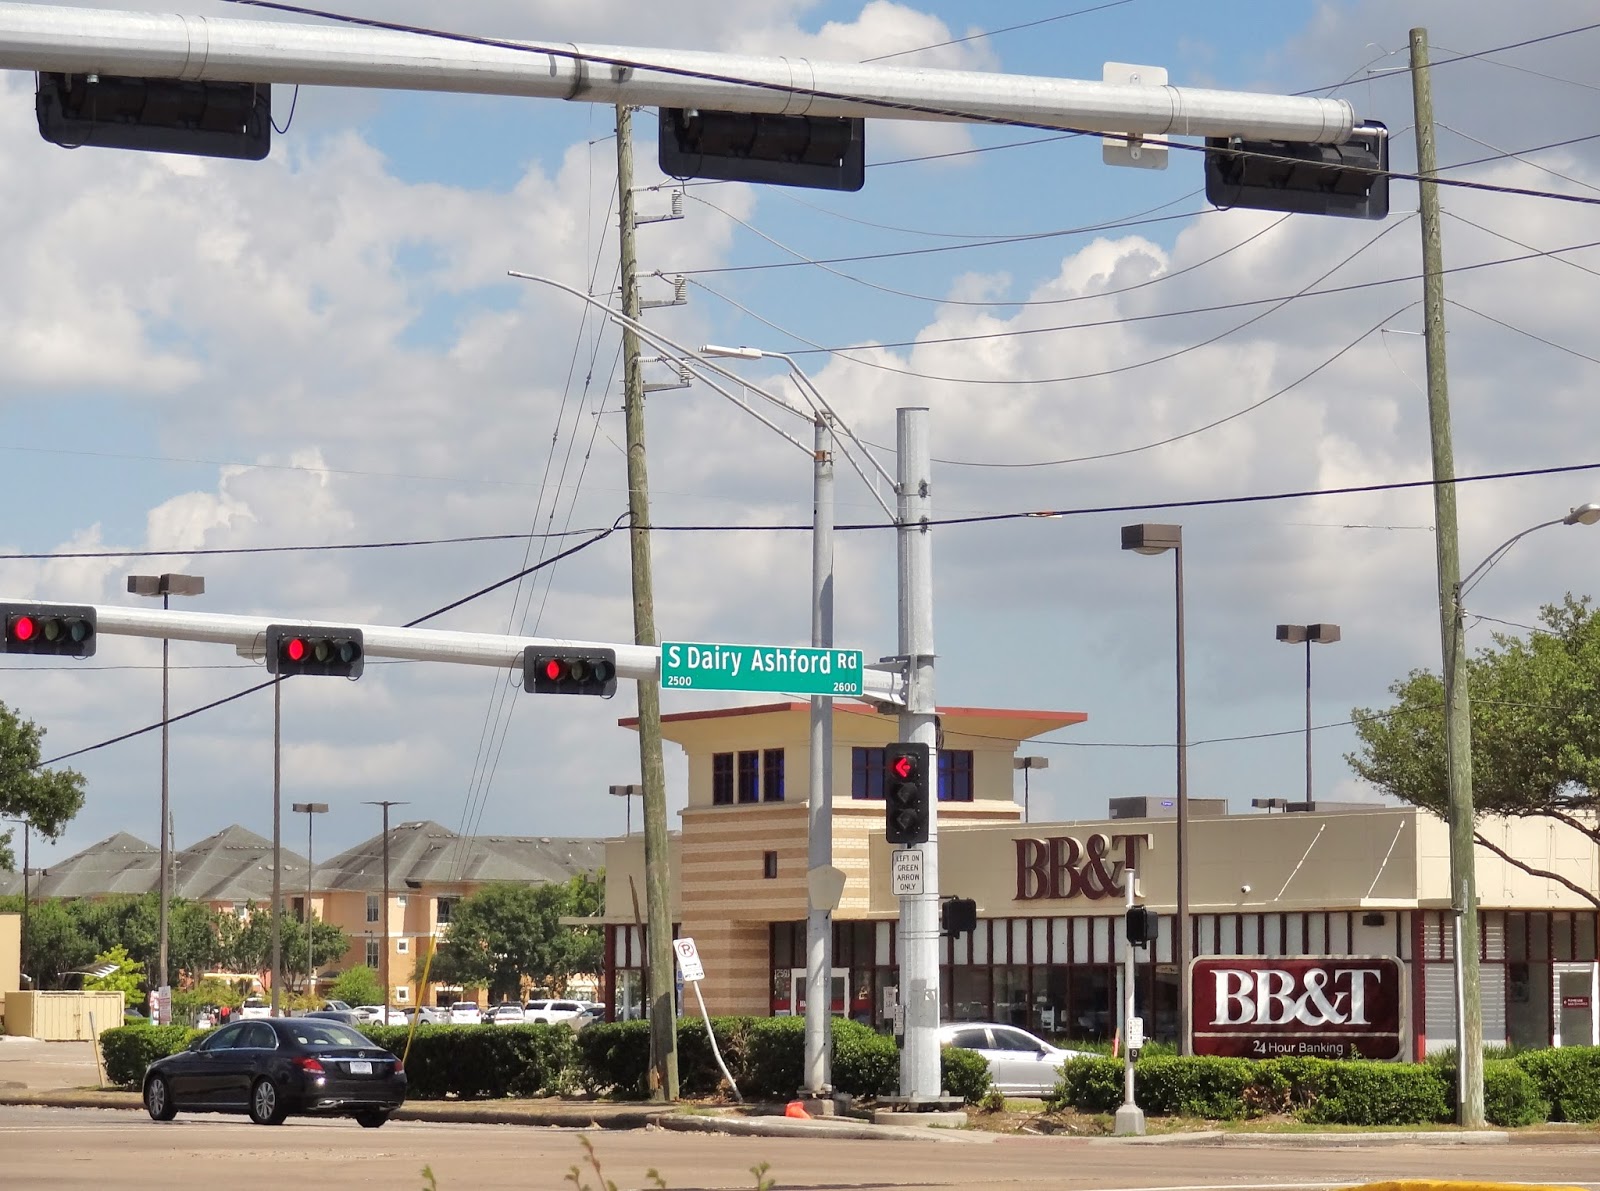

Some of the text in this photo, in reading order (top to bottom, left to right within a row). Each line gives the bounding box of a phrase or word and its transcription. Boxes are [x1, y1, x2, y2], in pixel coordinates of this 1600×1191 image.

[668, 646, 857, 676] S Dairy Ashford Rd
[668, 676, 692, 686] 2500
[833, 682, 857, 692] 2600
[1011, 833, 1153, 901] BB&T
[1209, 968, 1381, 1026] BB&T
[1253, 1039, 1343, 1054] 24 Hour Banking
